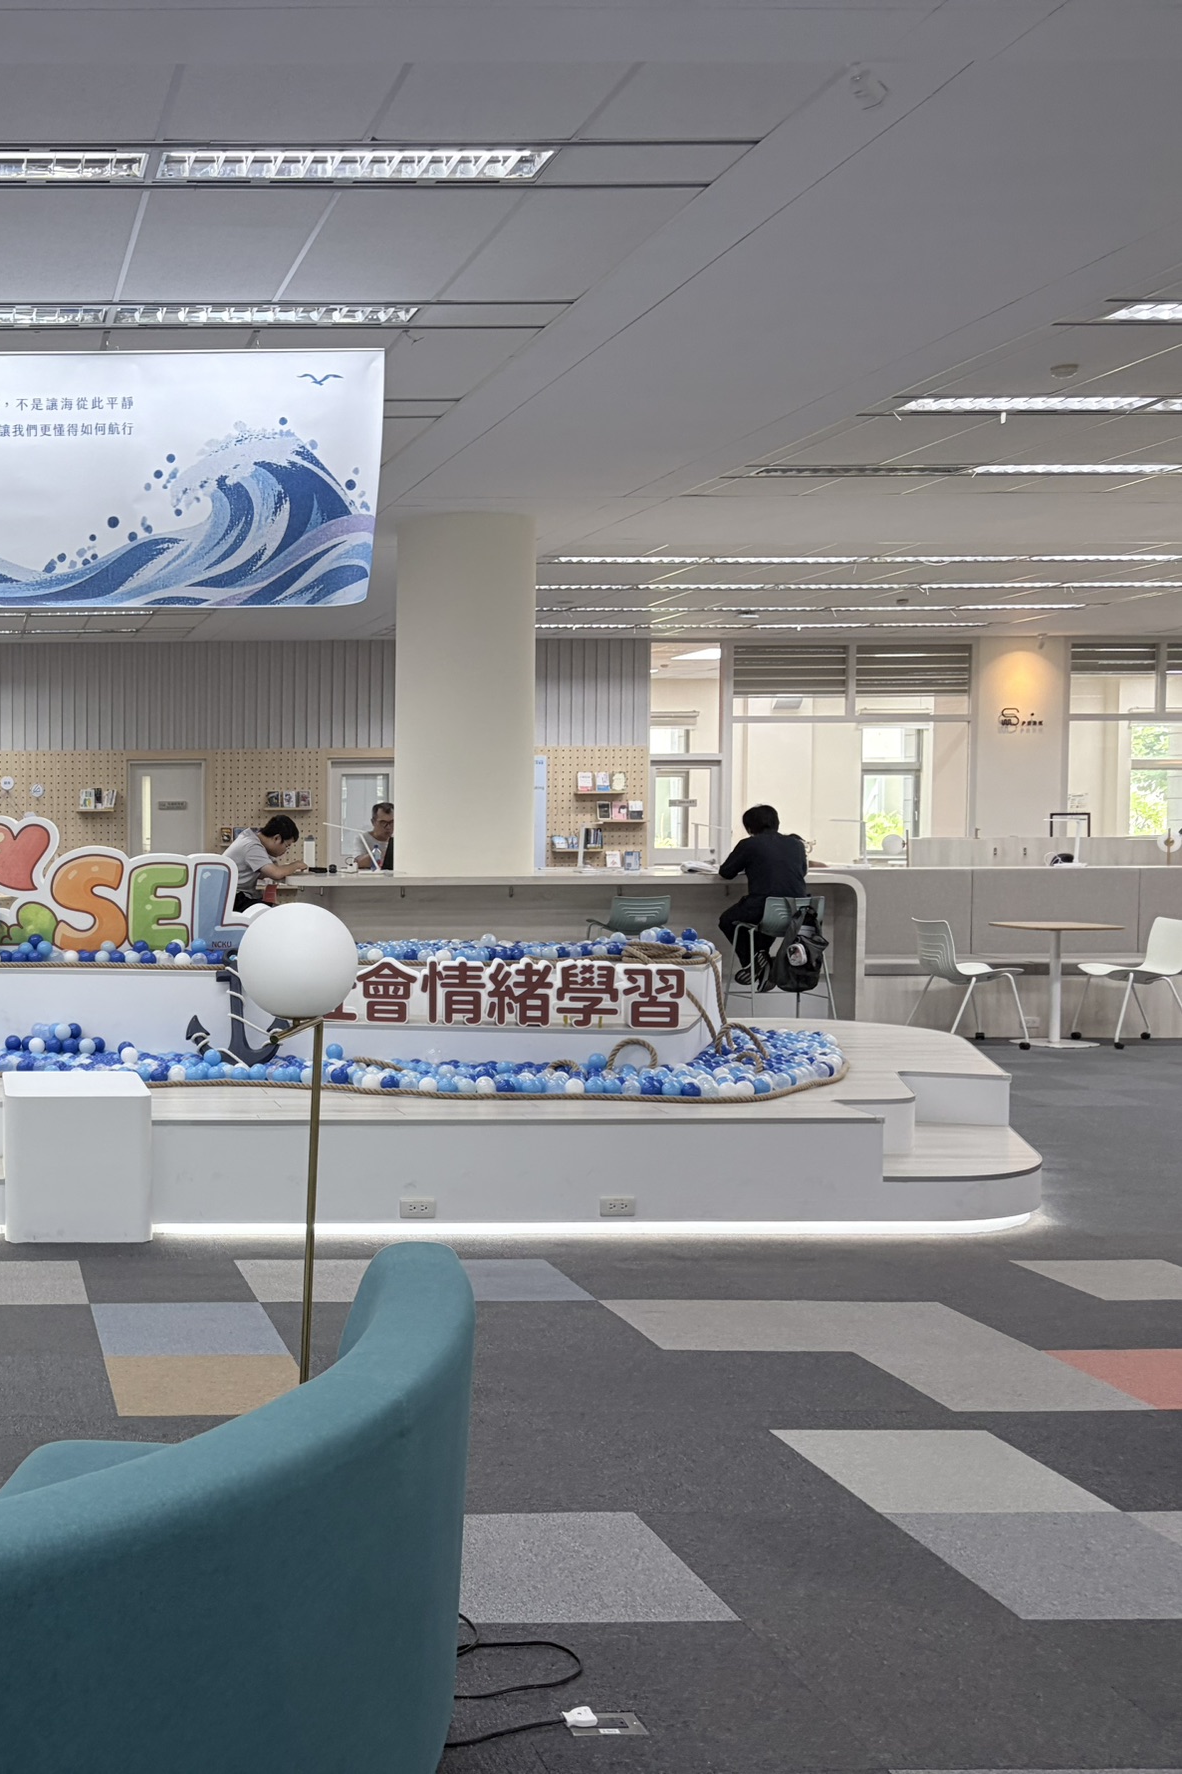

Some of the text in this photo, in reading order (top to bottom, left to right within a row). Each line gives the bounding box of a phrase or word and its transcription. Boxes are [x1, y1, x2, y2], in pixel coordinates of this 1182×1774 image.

[50, 853, 249, 951] SEL
[323, 964, 685, 1028] 會情緒學習
